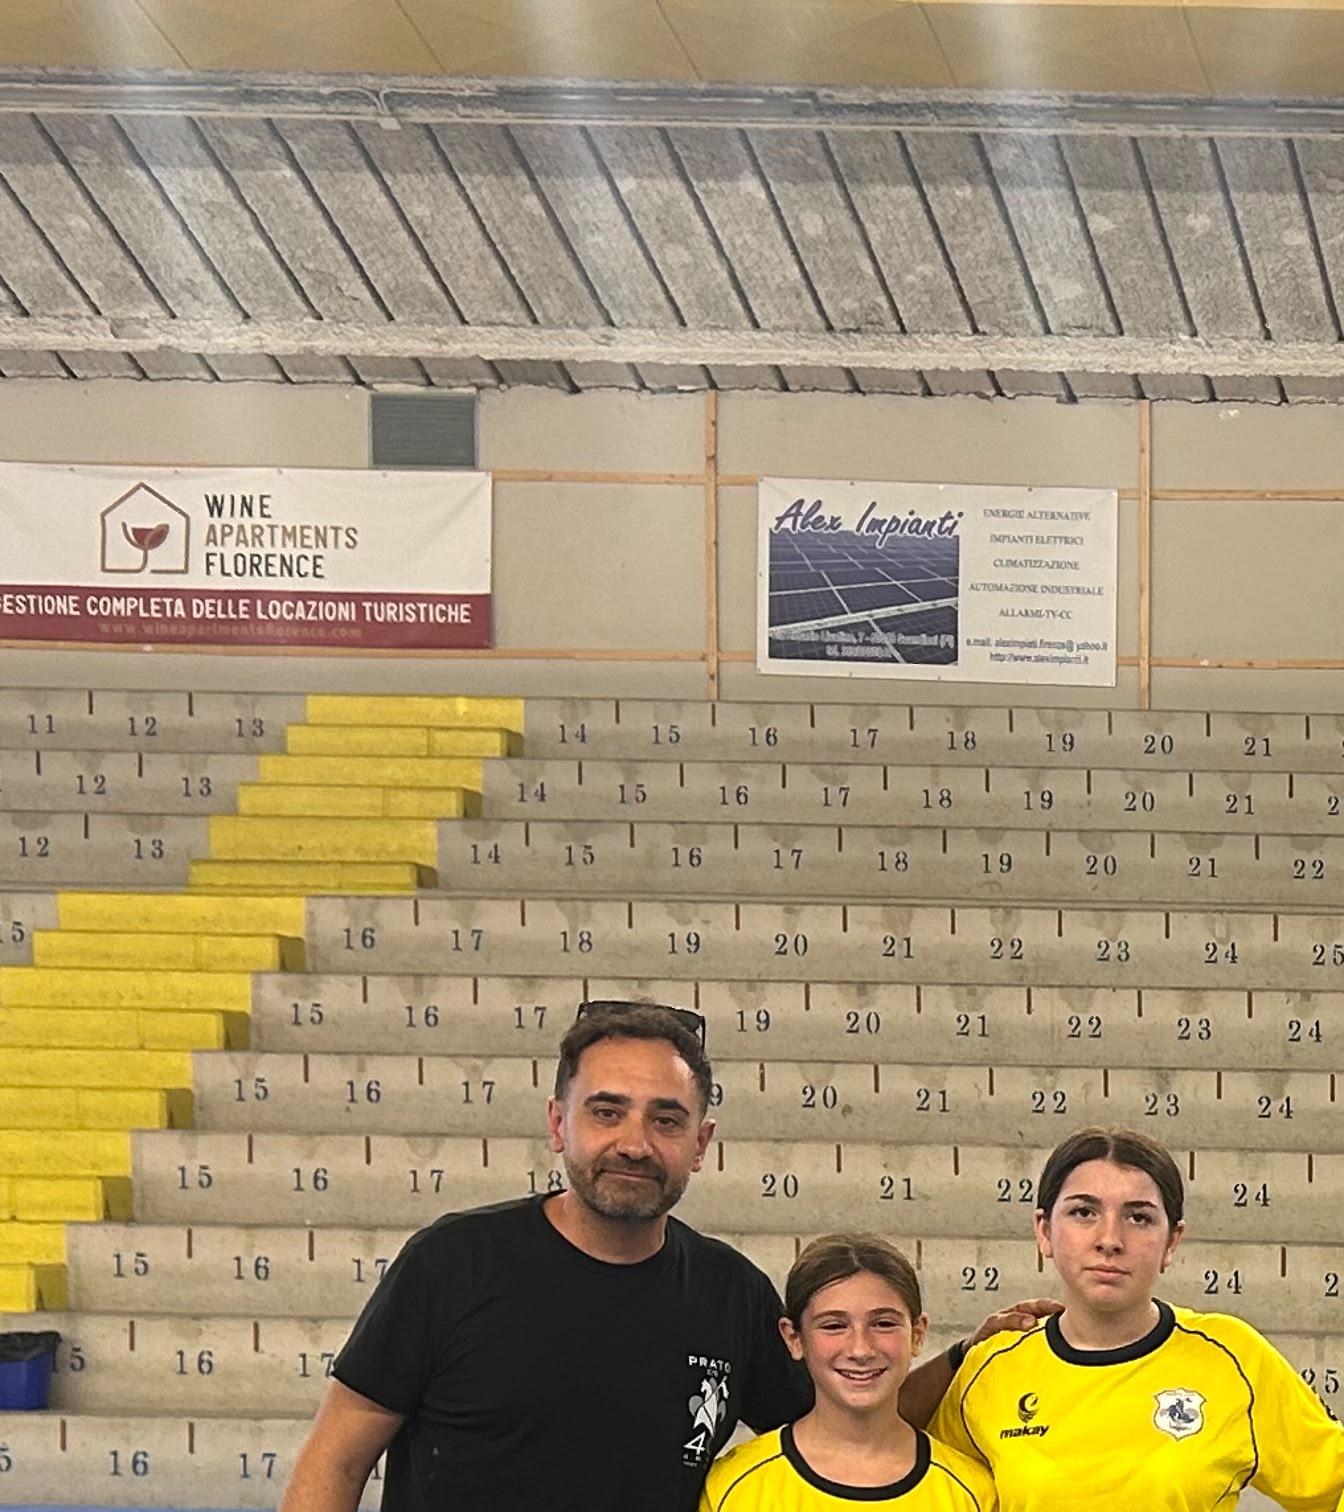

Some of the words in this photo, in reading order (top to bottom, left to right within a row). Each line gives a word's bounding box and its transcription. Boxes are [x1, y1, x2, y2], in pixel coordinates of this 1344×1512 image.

[205, 493, 272, 518] WINE
[774, 499, 842, 533] Alex
[856, 501, 963, 548] Impianti
[205, 524, 358, 549] APARTMENTS
[205, 553, 325, 579] FLORENCE
[993, 559, 1080, 570] CLIMATIZZAZIONE
[968, 583, 1039, 593] AUTOMAZIONE
[87, 596, 186, 618] COMPLETA
[192, 598, 250, 618] DELLE
[257, 600, 356, 621] LOCAZIONI
[362, 602, 471, 623] TURISTICHE
[128, 716, 158, 737] 12
[850, 728, 879, 749] 17
[182, 776, 212, 798] 13
[922, 788, 953, 809] 18
[134, 838, 164, 860] 13
[878, 851, 909, 873] 18
[343, 927, 376, 951] 16
[774, 933, 808, 956] 20
[291, 1003, 324, 1027] 15
[956, 1014, 990, 1038] 21
[235, 1077, 269, 1103] 15
[801, 1084, 837, 1109] 20
[293, 1167, 329, 1192] 16
[879, 1175, 915, 1201] 21
[1233, 1183, 1271, 1208] 24
[113, 1252, 149, 1278] 15
[961, 1266, 999, 1292] 22
[176, 1349, 214, 1376] 16
[688, 1355, 731, 1374] PRATO
[1000, 1422, 1049, 1441] makay
[239, 1452, 277, 1479] 17
